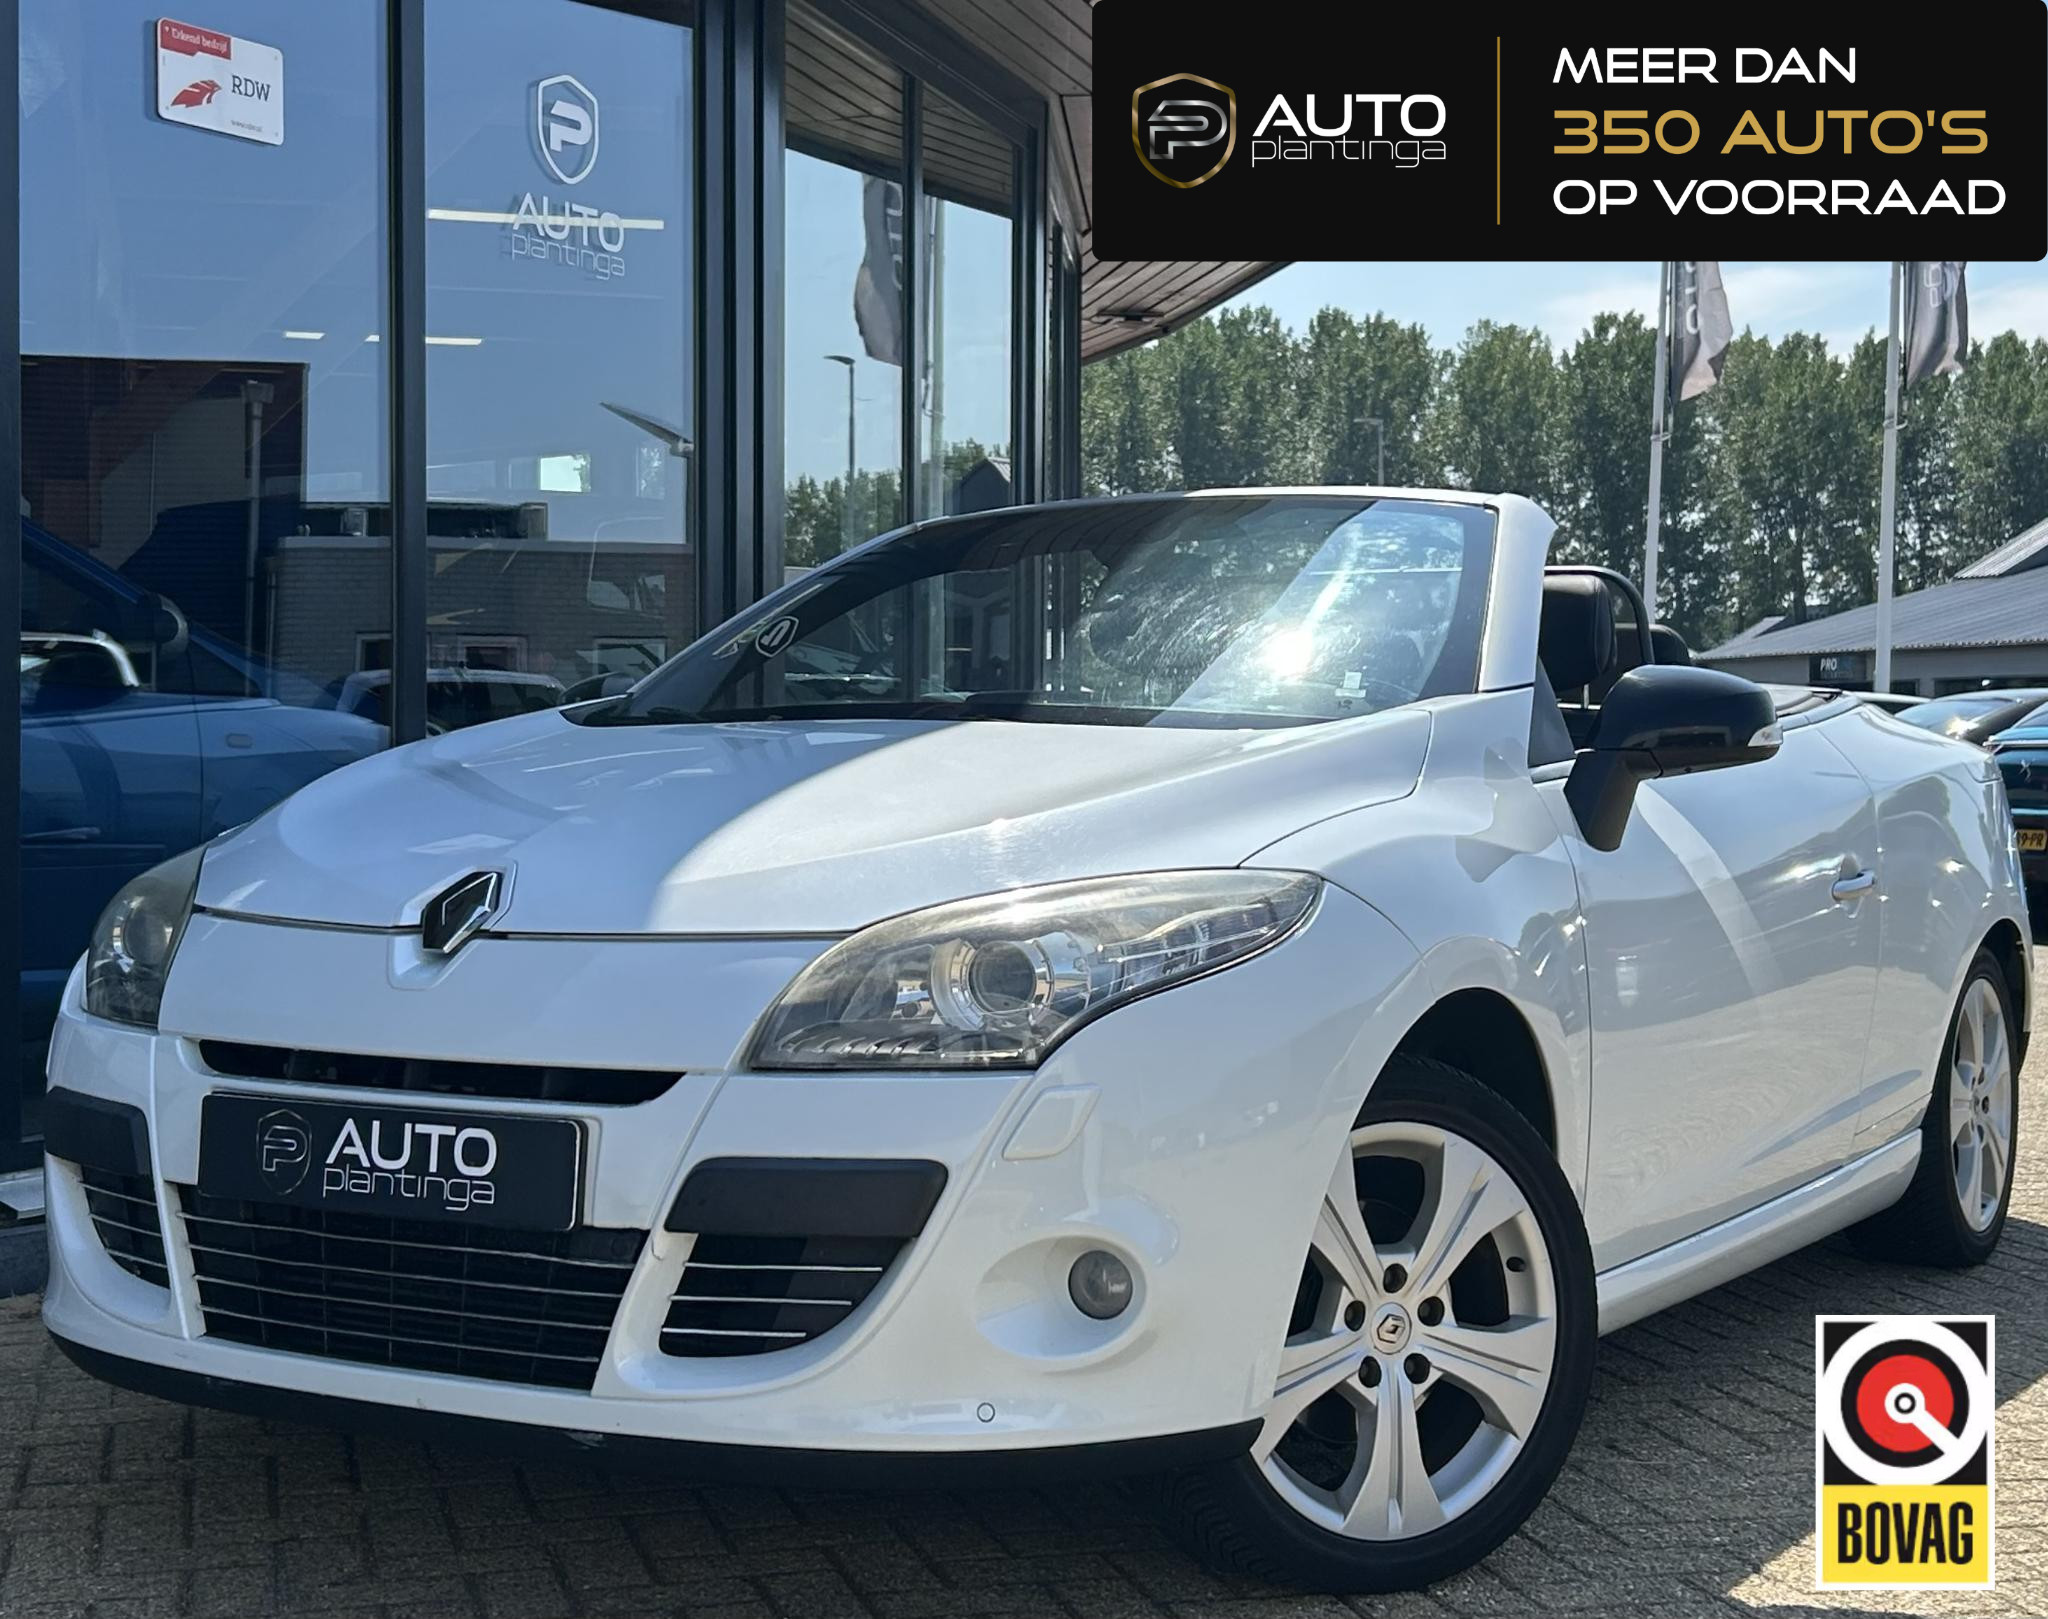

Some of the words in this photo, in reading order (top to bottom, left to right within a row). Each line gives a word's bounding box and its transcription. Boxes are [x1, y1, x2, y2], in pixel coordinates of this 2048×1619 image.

[231, 75, 271, 102] RDW
[513, 192, 625, 253] AUTO
[512, 233, 626, 280] plantinga
[326, 1117, 498, 1177] AUTO
[323, 1163, 495, 1212] plantinga
